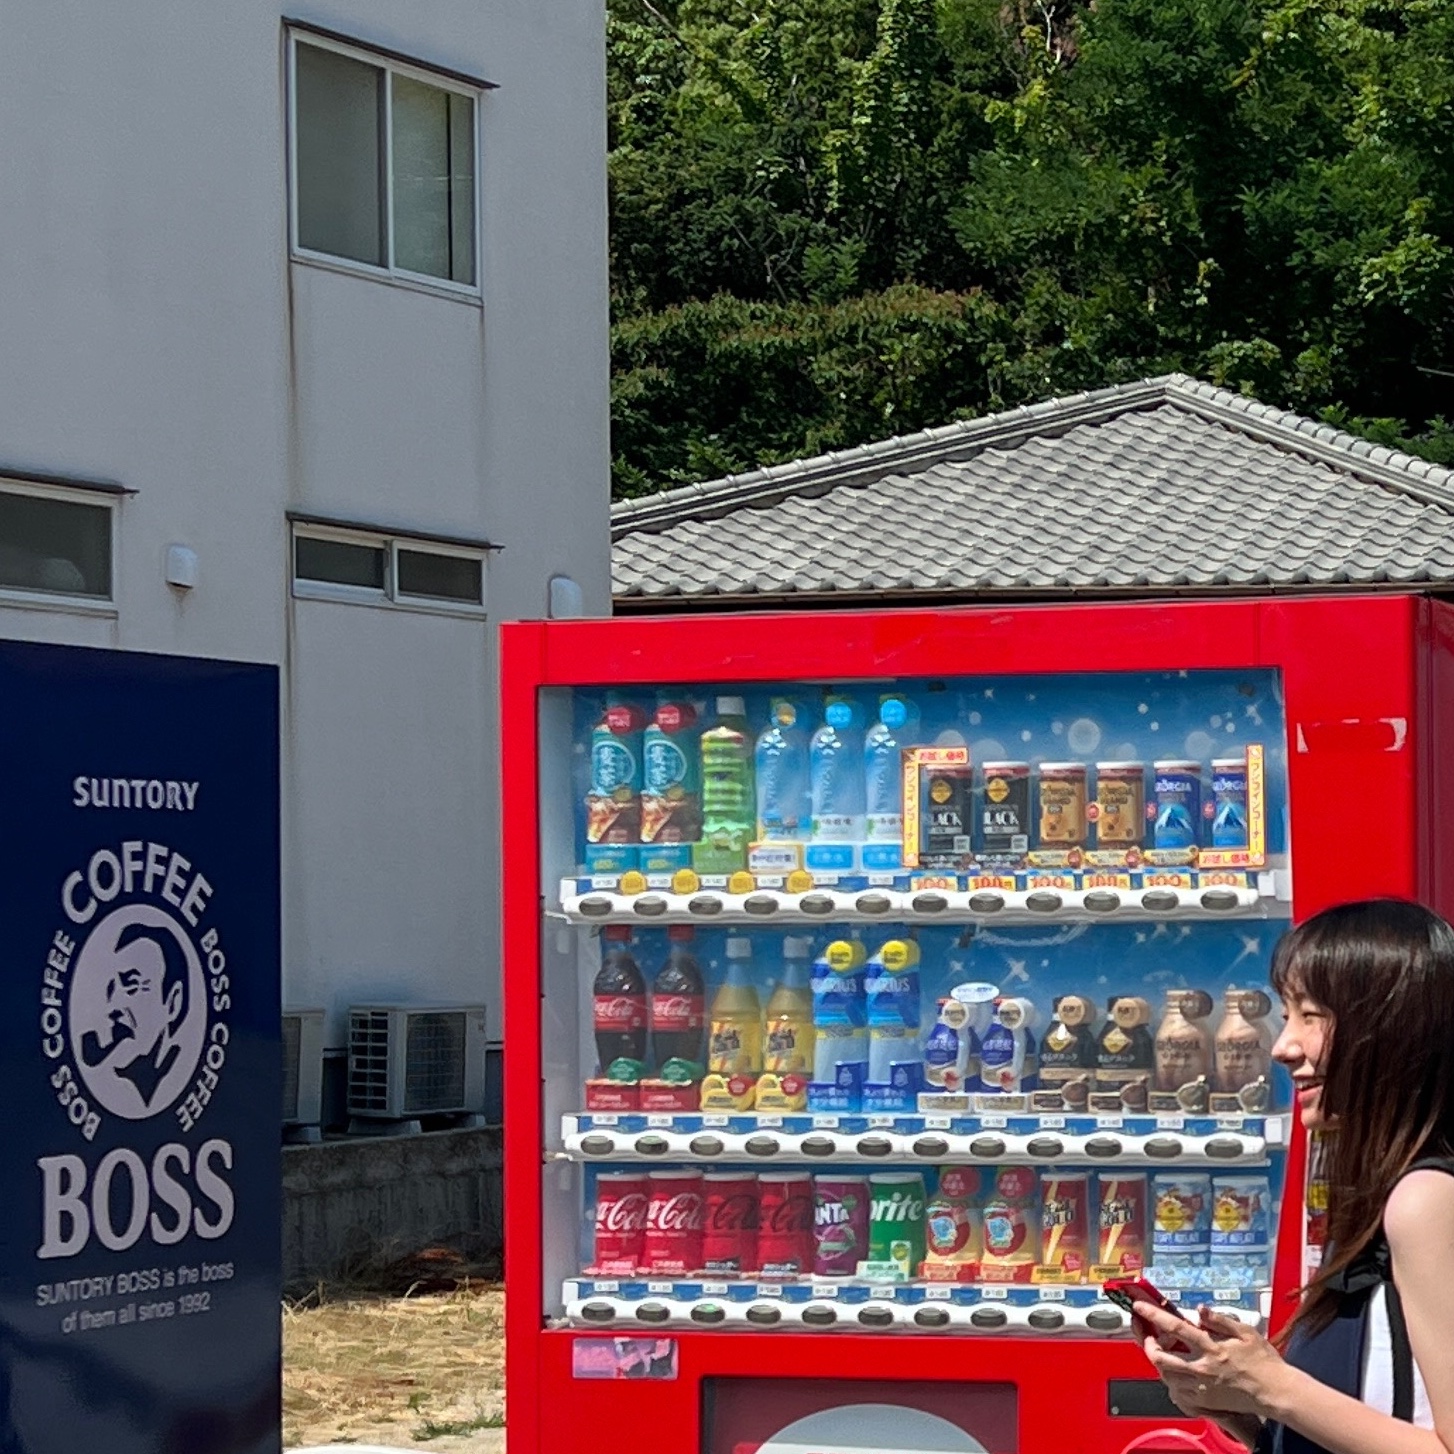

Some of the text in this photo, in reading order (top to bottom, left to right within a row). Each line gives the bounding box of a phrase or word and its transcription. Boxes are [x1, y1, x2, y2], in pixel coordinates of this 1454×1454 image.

[61, 840, 213, 927] COFFEE
[41, 929, 101, 1141] BOSS COFFEE
[175, 927, 231, 1132] BOSS COFFEE
[36, 1138, 235, 1260] BOSS
[37, 1262, 234, 1306] SUNTORY BOSS is the boss
[61, 1292, 211, 1333] of them all since 1992
